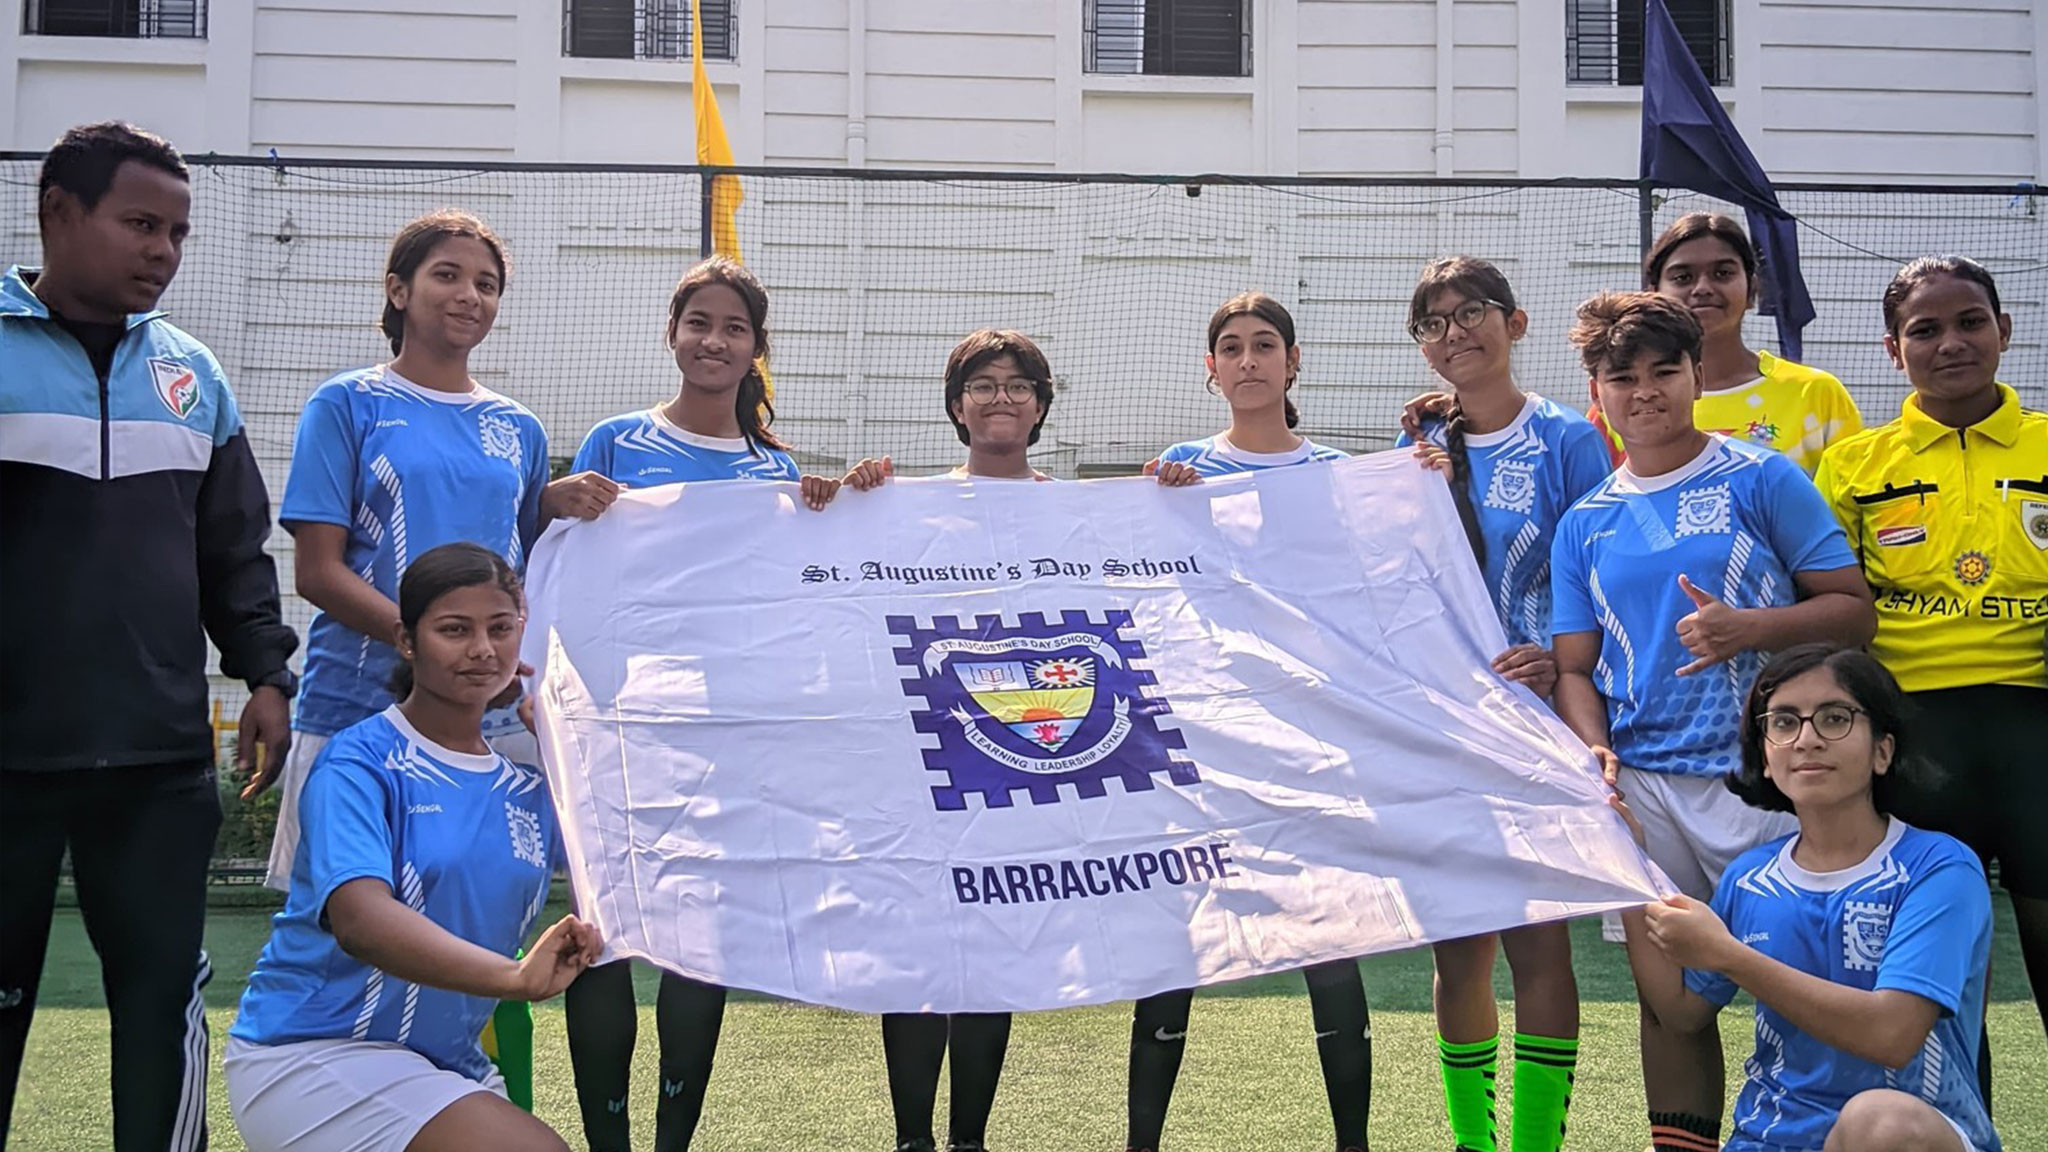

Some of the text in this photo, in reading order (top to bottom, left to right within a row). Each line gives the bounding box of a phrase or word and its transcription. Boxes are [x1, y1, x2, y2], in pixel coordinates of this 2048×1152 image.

[801, 555, 1202, 585] St. Augustine's Day School
[1030, 640, 1052, 649] DAY
[971, 721, 1128, 771] LEARNING LEADERSHIP LOYALTY
[952, 843, 1240, 904] BARRACKPORE
